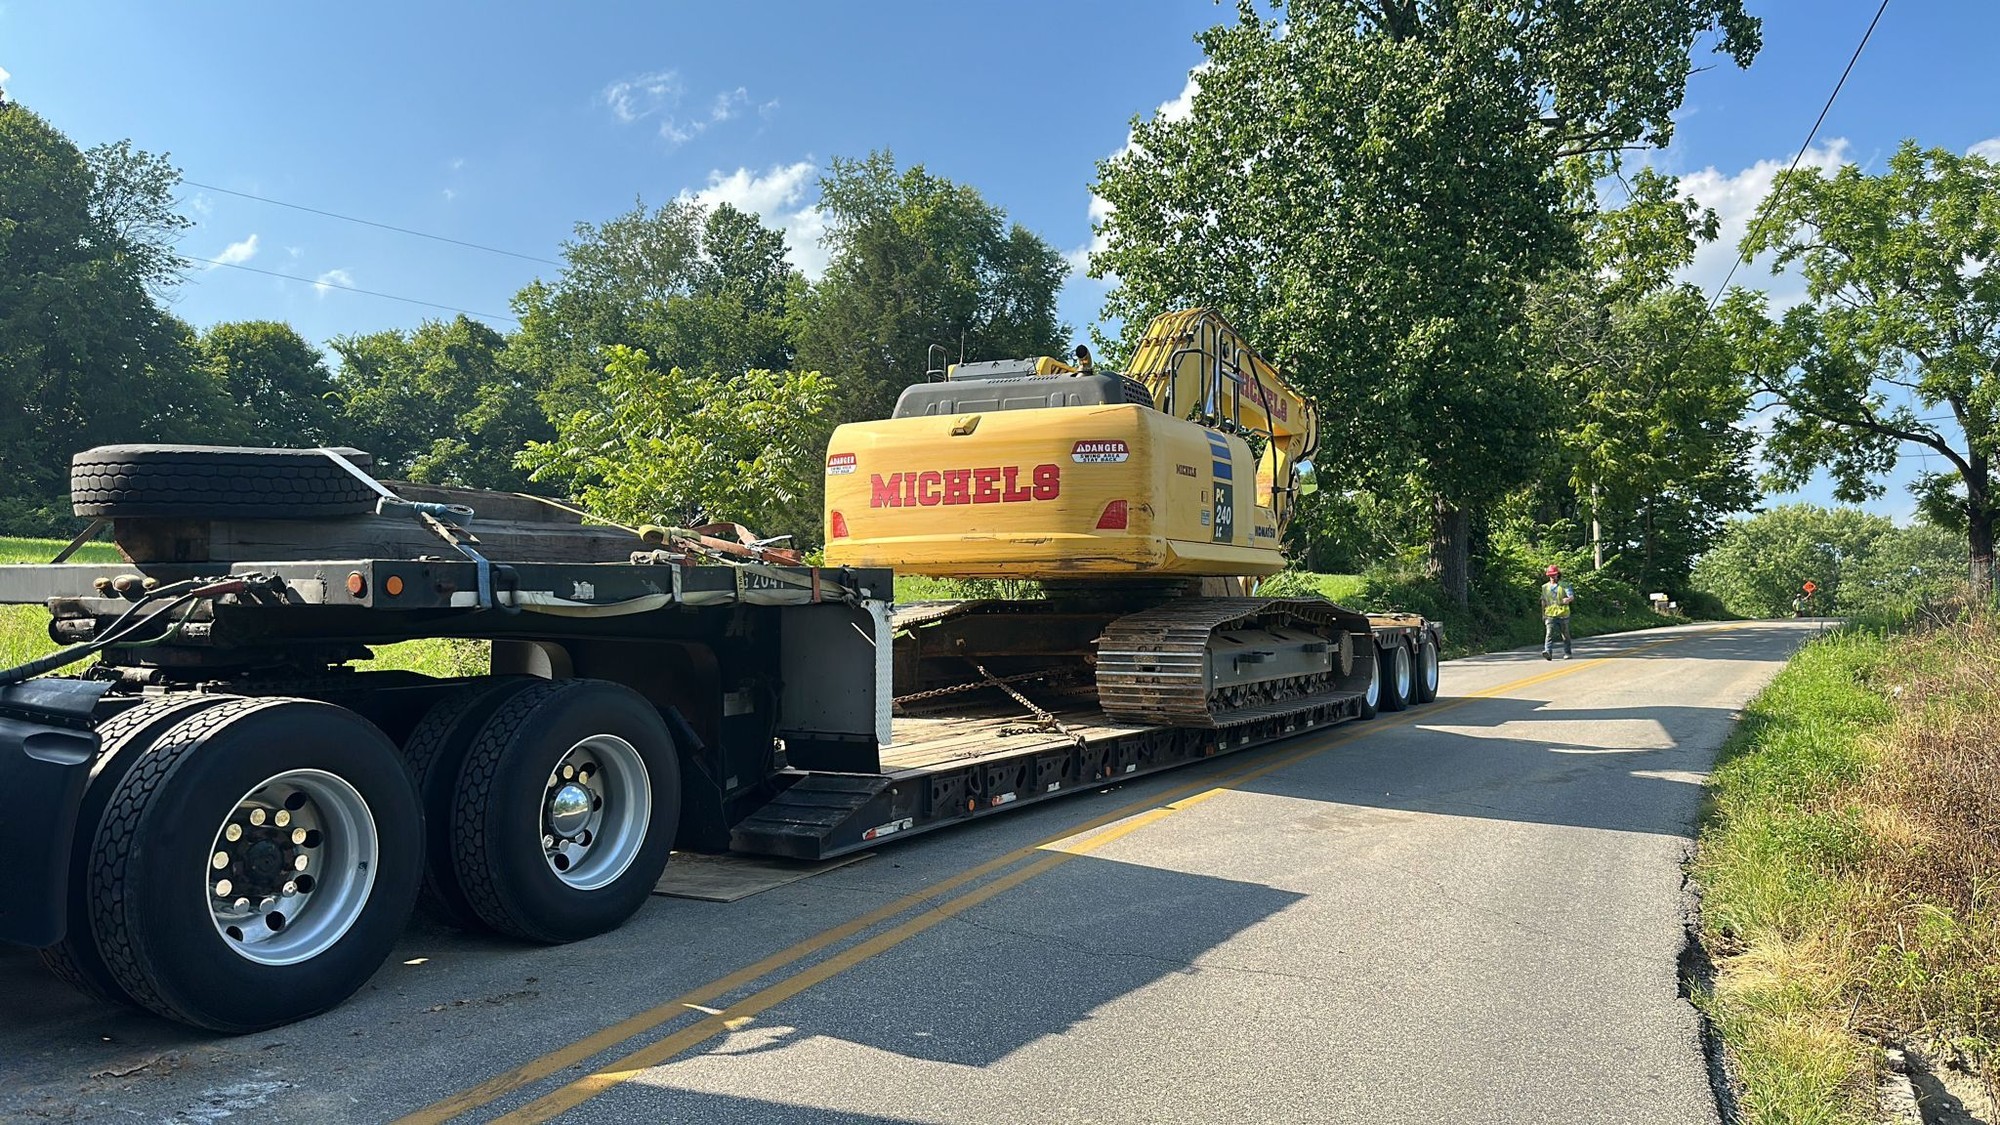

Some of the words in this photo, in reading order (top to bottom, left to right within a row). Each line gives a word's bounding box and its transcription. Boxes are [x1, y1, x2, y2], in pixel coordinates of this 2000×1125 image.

[1085, 443, 1124, 452] DANGER
[1176, 464, 1197, 478] MICHELS
[870, 464, 1060, 508] MICHELS
[1216, 488, 1225, 503] PC
[1216, 505, 1231, 525] 240
